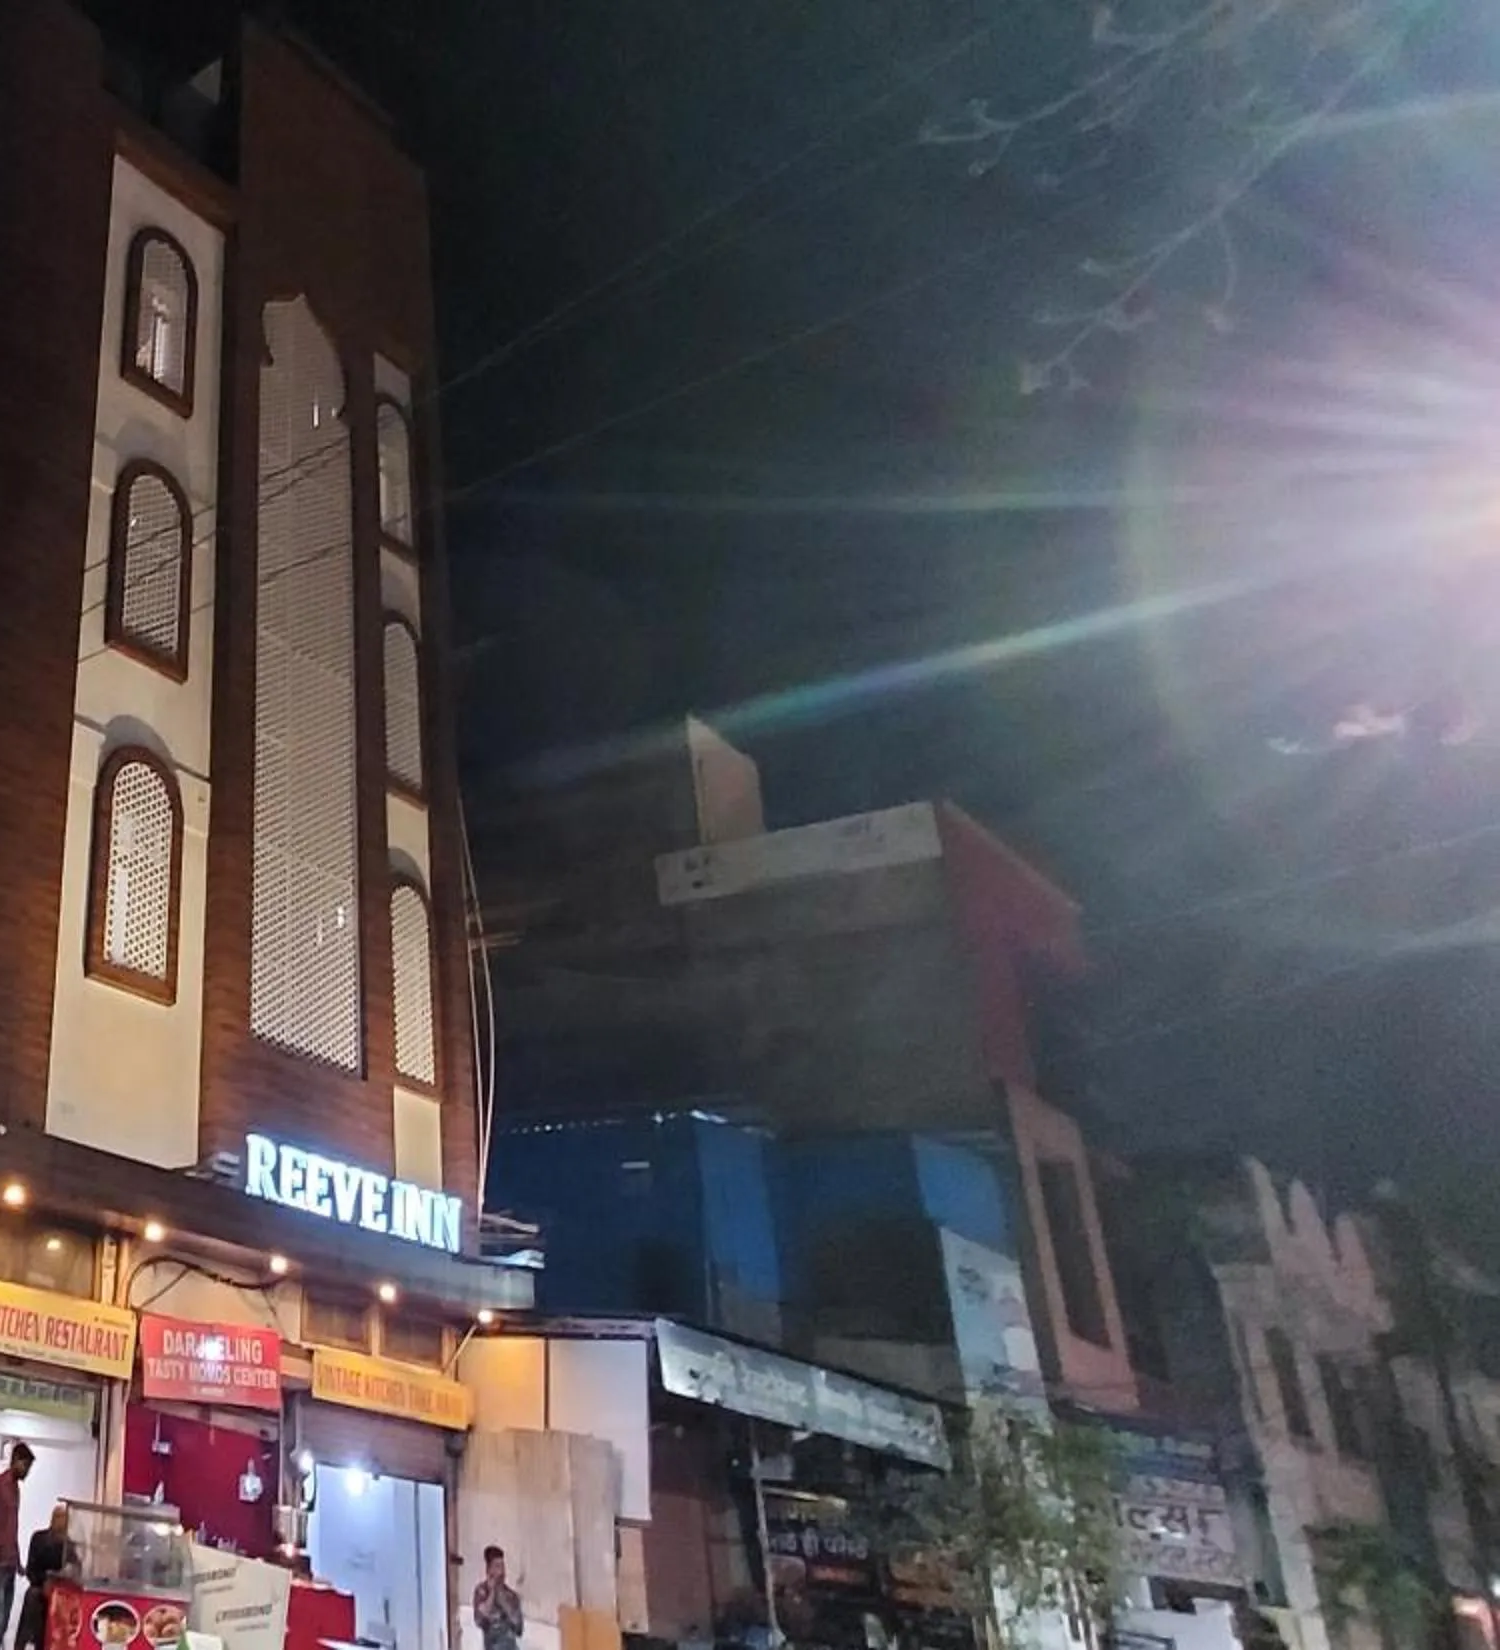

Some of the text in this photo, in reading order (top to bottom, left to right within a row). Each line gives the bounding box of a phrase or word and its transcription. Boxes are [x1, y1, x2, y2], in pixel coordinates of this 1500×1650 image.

[245, 1132, 462, 1254] REEVE INN
[44, 1315, 130, 1362] RESTAURANT
[163, 1329, 263, 1365] DARJELING
[147, 1357, 184, 1380] TASTY
[233, 1366, 278, 1390] CENTER
